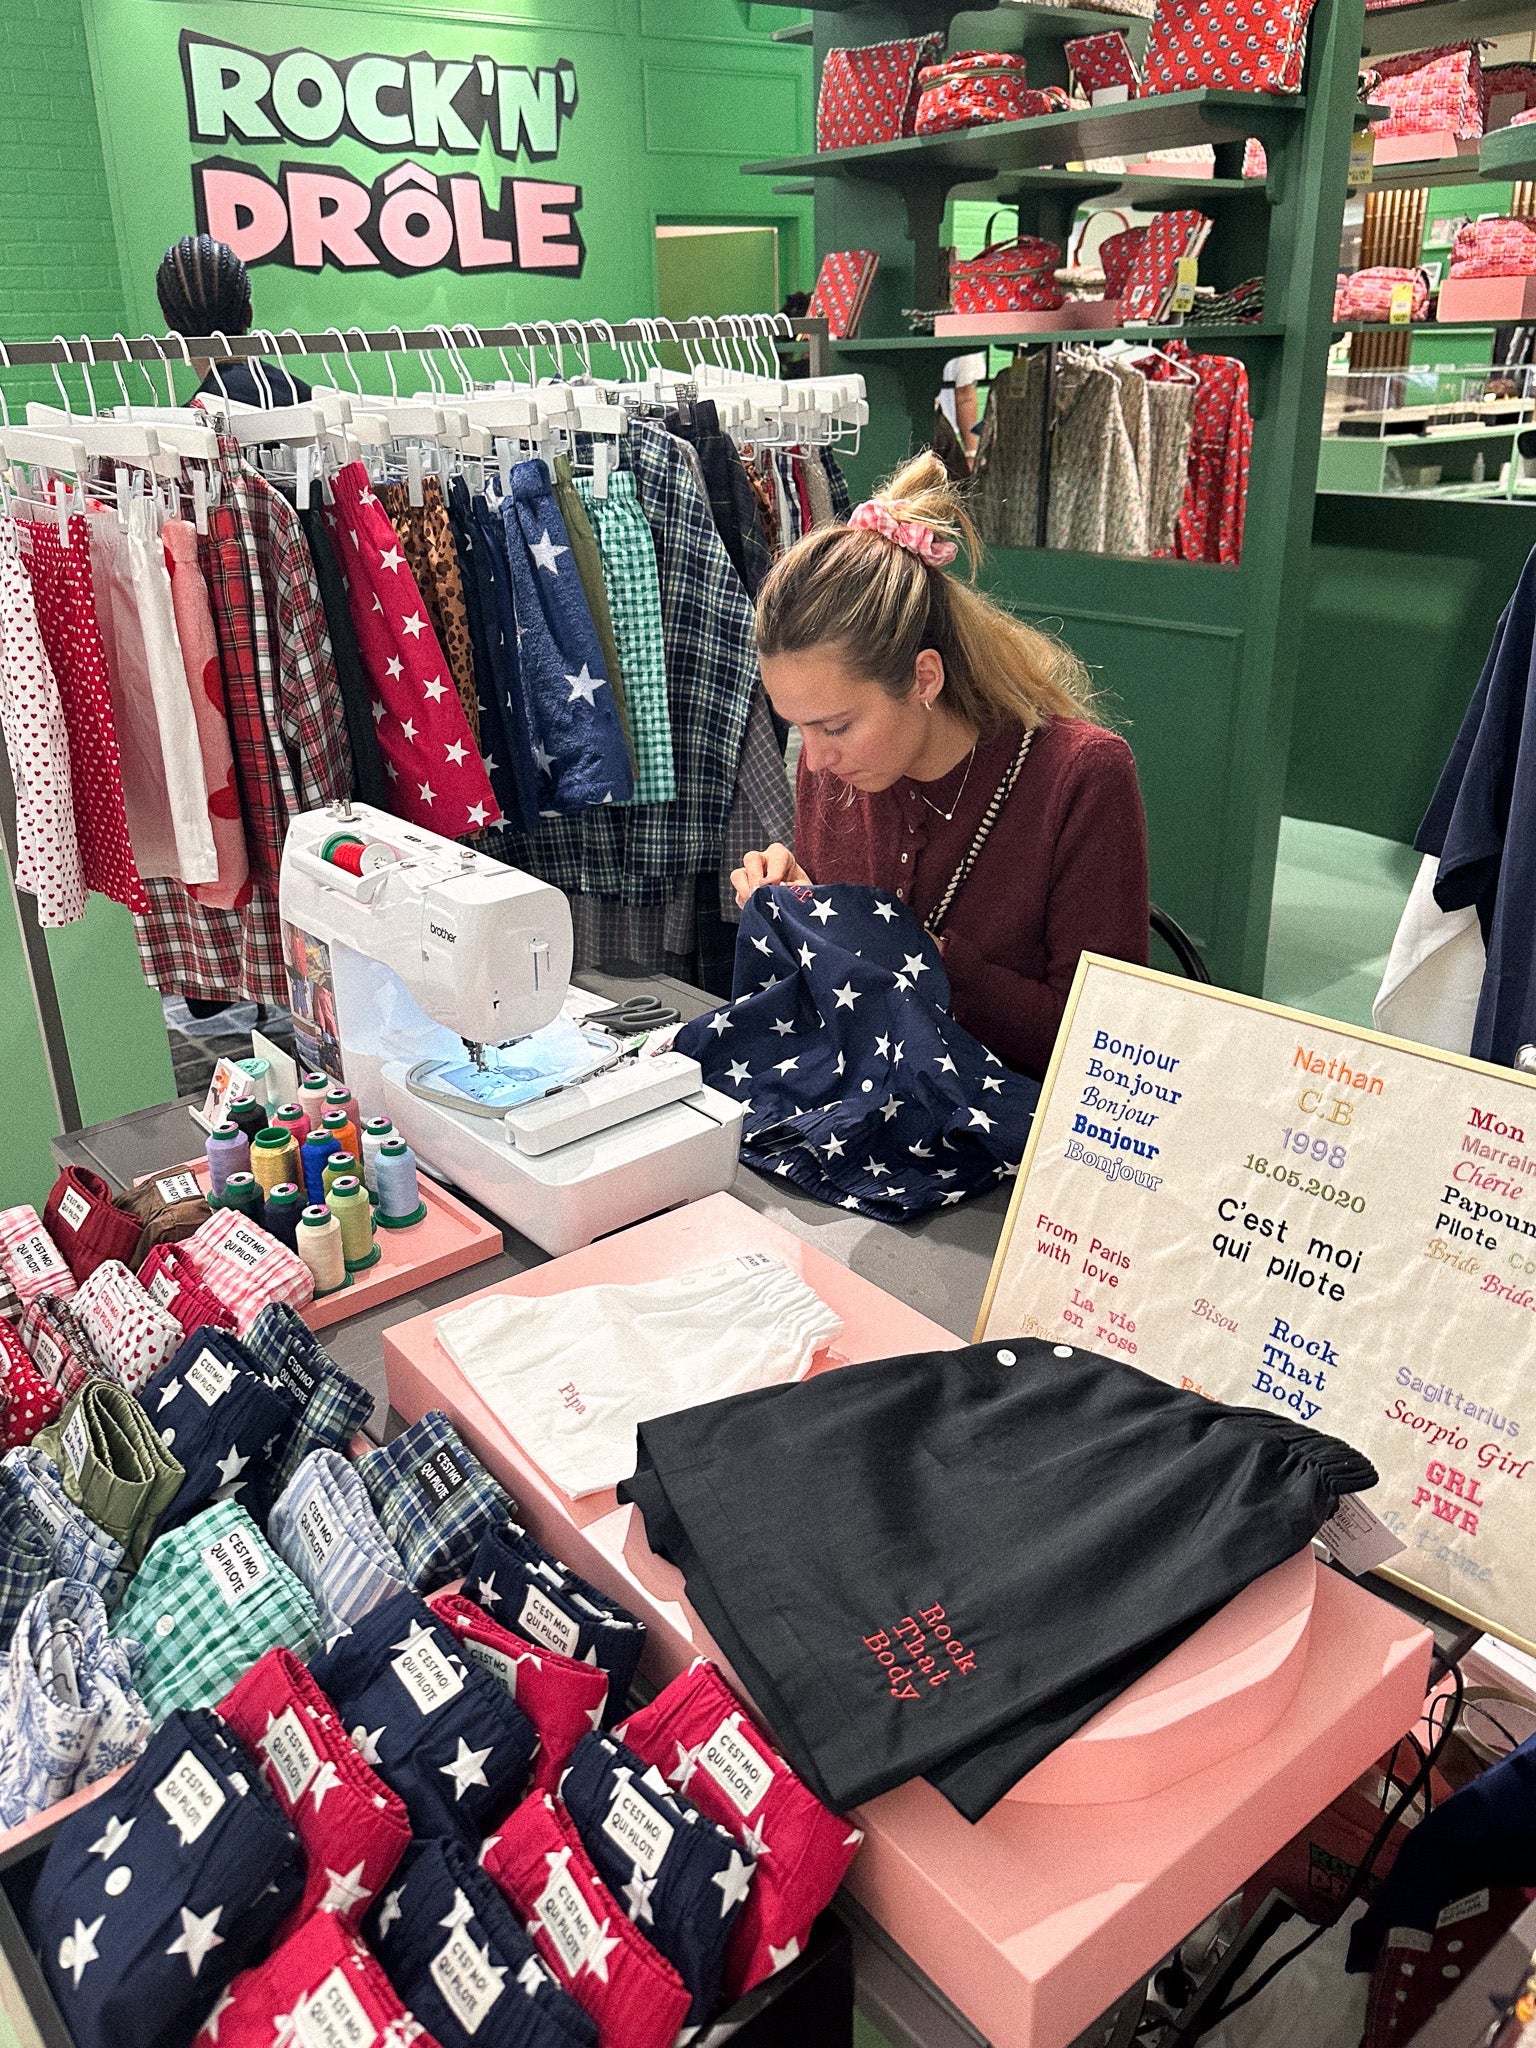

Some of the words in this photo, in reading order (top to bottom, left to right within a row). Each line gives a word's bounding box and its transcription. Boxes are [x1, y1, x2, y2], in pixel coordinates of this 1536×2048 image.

[187, 42, 576, 153] ROCK'N'
[201, 160, 580, 269] DRÔLE
[430, 922, 456, 943] brother
[1093, 1030, 1179, 1073] Bonjour
[1293, 1046, 1384, 1095] Nathan
[1085, 1058, 1182, 1105] Bonjour
[1080, 1085, 1159, 1127] Bonjour
[1298, 1088, 1353, 1126] C.B
[1467, 1107, 1525, 1143] Mon
[1072, 1113, 1159, 1160] Bonjour
[1282, 1127, 1346, 1169] 1998
[1064, 1139, 1163, 1192] Bonjour
[1243, 1153, 1366, 1213] 16.05.2020
[1452, 1161, 1524, 1200] Chérie
[30, 1237, 44, 1257] C'EST
[224, 1240, 237, 1251] QUI
[234, 1248, 257, 1266] PILOTE
[236, 1230, 254, 1246] C'EST
[252, 1244, 267, 1255] MOI
[1037, 1214, 1078, 1244] From
[1089, 1238, 1131, 1269] Paris
[1218, 1198, 1288, 1243] C'est
[1307, 1238, 1363, 1273] moi
[1435, 1213, 1497, 1250] Pilote
[17, 1243, 28, 1256] QUI
[24, 1254, 41, 1274] PILOTE
[1037, 1240, 1071, 1265] with
[1082, 1259, 1119, 1288] love
[1212, 1233, 1252, 1262] qui
[1266, 1256, 1345, 1301] pilote
[1424, 1237, 1480, 1275] Bride
[1063, 1309, 1084, 1329] en
[1096, 1326, 1137, 1355] rose
[1070, 1289, 1095, 1313] La
[1109, 1311, 1136, 1333] vie
[1192, 1298, 1239, 1333] Bisou
[1269, 1317, 1339, 1368] Rock
[192, 1368, 202, 1380] QUI
[199, 1376, 216, 1396] PILOTE
[201, 1359, 217, 1376] C'EST
[280, 1368, 289, 1384] QUI
[287, 1381, 308, 1404] PILOTE
[288, 1356, 304, 1376] C'EST
[300, 1373, 315, 1389] MOI
[1262, 1343, 1326, 1391] That
[558, 1382, 586, 1414] Pipa
[1252, 1369, 1322, 1420] Body
[1396, 1366, 1520, 1437] Sagittarius
[1385, 1399, 1468, 1451] Scorpio
[1477, 1443, 1534, 1479] Girl
[420, 1463, 437, 1480] QUI
[430, 1477, 449, 1499] PILOTE
[436, 1452, 452, 1475] C'EST
[448, 1470, 462, 1486] MOI
[1426, 1459, 1484, 1507] GRL
[42, 1519, 57, 1538] MOI
[309, 1501, 324, 1526] C'EST
[320, 1523, 333, 1546] MOI
[1412, 1485, 1479, 1536] PWR
[229, 1533, 250, 1558] C'EST
[242, 1557, 260, 1579] MOI
[301, 1513, 311, 1533] QUI
[308, 1529, 325, 1563] PILOTE
[211, 1543, 228, 1561] QUI
[222, 1560, 245, 1594] PILOTE
[526, 1612, 541, 1628] QUI
[541, 1625, 568, 1652] PILOTE
[532, 1600, 553, 1621] C'EST
[553, 1619, 571, 1637] MOI
[918, 1602, 977, 1675] Rock
[417, 1649, 438, 1671] C'EST
[433, 1669, 450, 1689] MOI
[862, 1629, 920, 1699] Body
[892, 1616, 951, 1686] That
[402, 1657, 418, 1674] QUI
[413, 1670, 437, 1702] PILOTE
[273, 1738, 285, 1758] QUI
[720, 1735, 745, 1762] C'EST
[741, 1760, 760, 1783] MOI
[707, 1747, 725, 1767] QUI
[723, 1764, 752, 1800] PILOTE
[612, 1813, 628, 1832] QUI
[628, 1828, 655, 1860] PILOTE
[622, 1798, 647, 1824] C'EST
[643, 1821, 662, 1840] MOI
[546, 1898, 561, 1920] QUI
